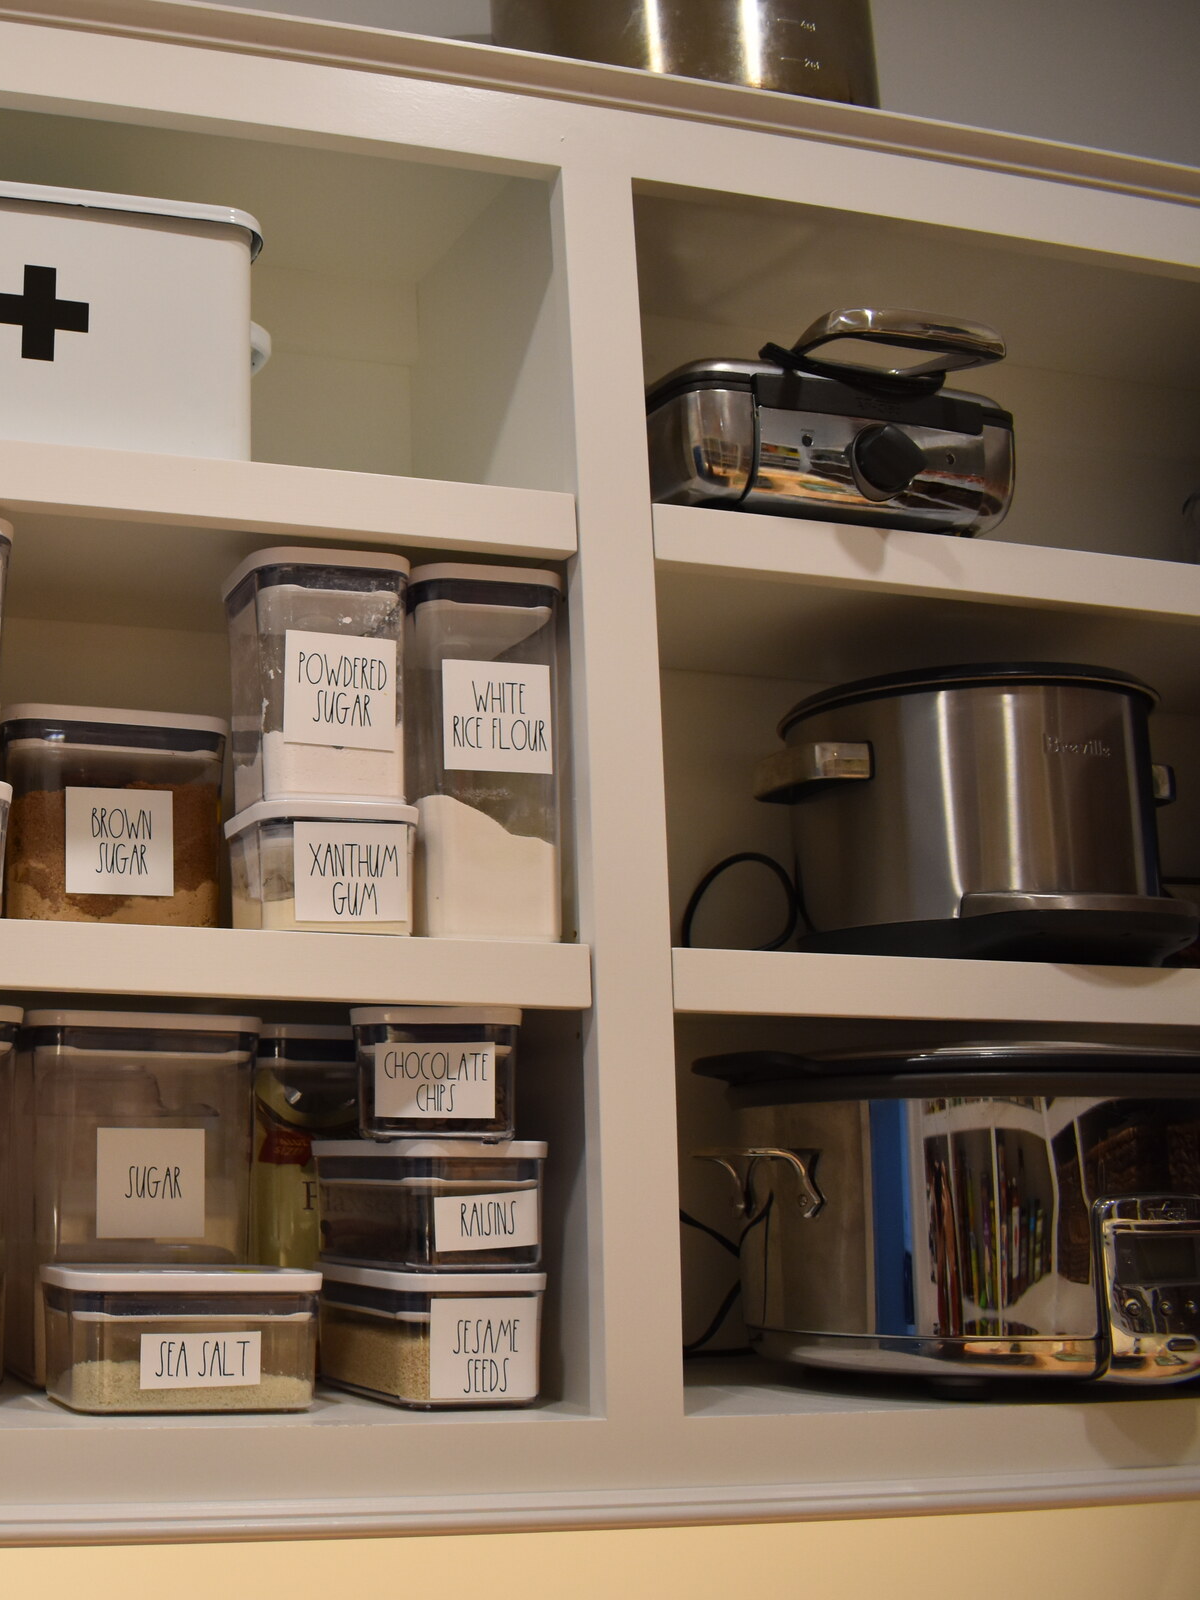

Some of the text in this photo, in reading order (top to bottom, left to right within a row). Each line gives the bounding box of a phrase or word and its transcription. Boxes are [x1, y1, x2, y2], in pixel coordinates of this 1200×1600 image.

[299, 652, 387, 690] POWDERED
[313, 690, 372, 727] SUGAR
[472, 681, 526, 714] WHITE
[453, 716, 548, 751] RICE FLOUR
[92, 808, 152, 841] BROWN
[96, 842, 149, 875] SUGAR
[309, 843, 399, 877] XANTHUM
[332, 881, 378, 916] GUM
[384, 1051, 489, 1082] CHOCOLATE
[415, 1083, 455, 1113] CHIPS
[125, 1166, 182, 1199] SUGAR
[460, 1201, 517, 1238] RAISINS
[453, 1319, 520, 1355] SESAME
[155, 1341, 250, 1378] SEA SALT
[463, 1358, 509, 1394] SEEDS
